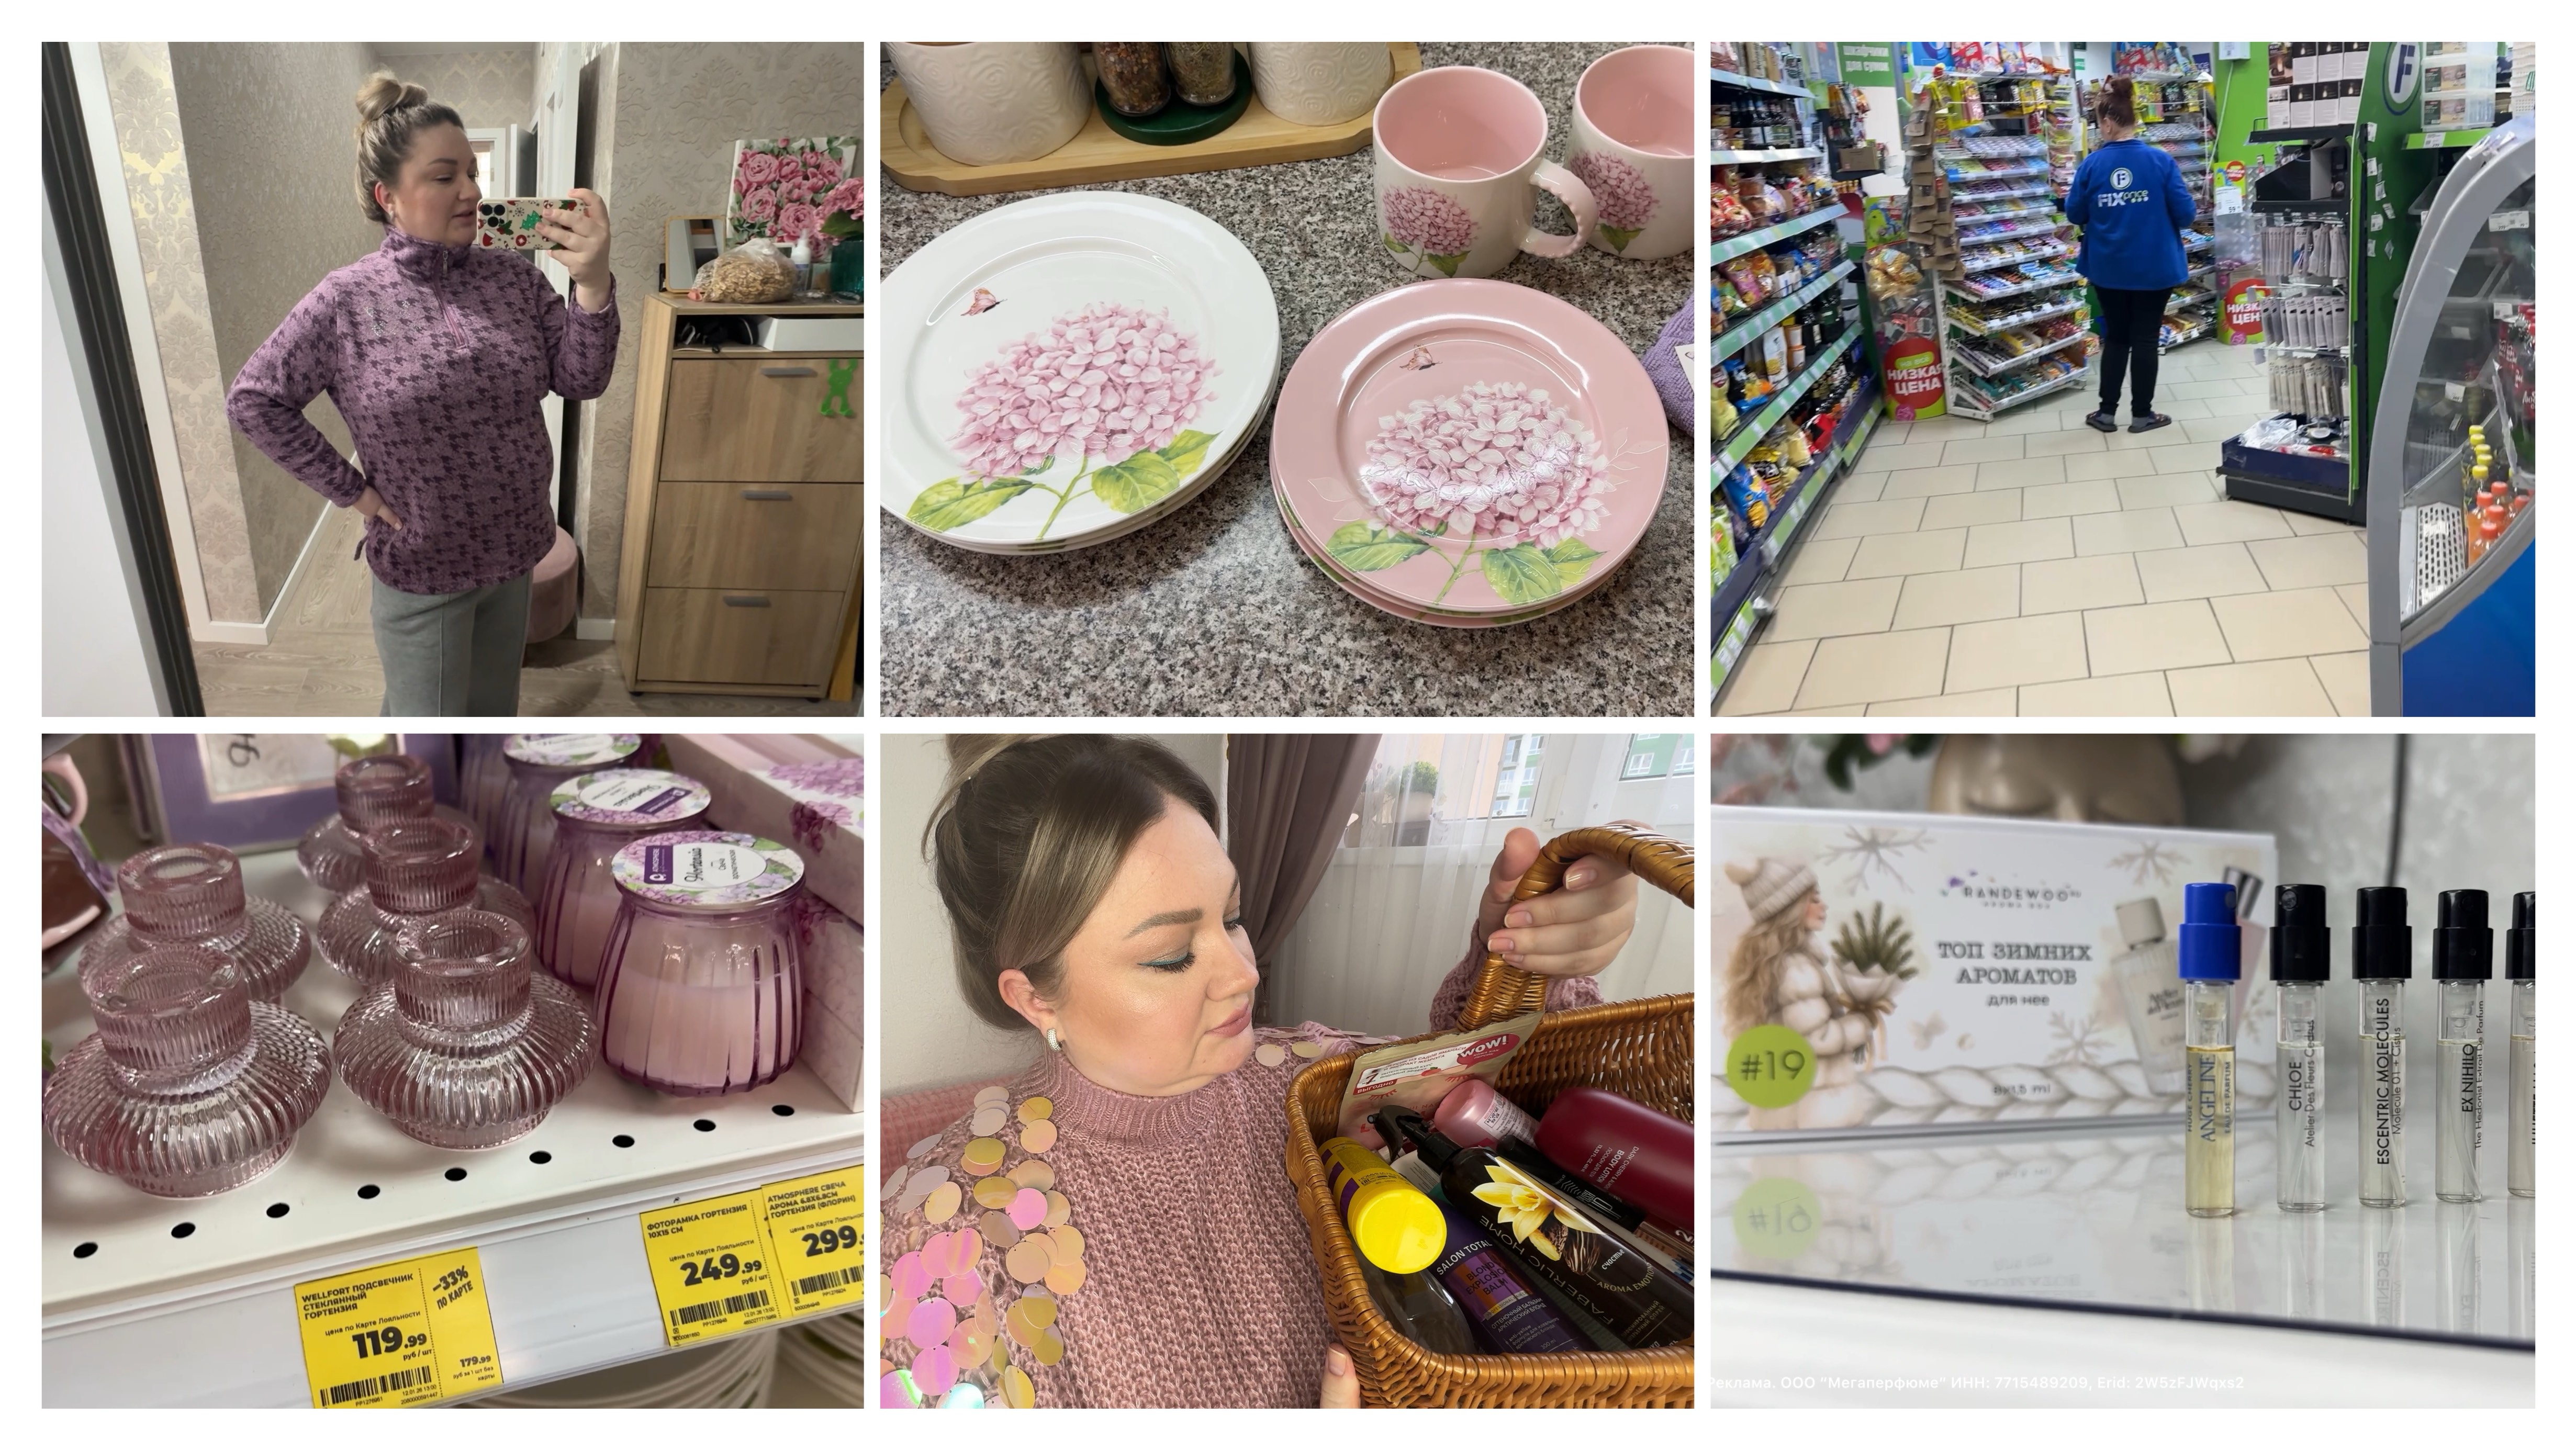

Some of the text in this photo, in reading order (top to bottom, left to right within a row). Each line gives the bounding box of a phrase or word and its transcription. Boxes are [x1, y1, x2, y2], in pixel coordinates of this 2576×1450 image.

[2233, 311, 2261, 325] ЦЕН
[1895, 377, 1942, 396] ЦЕНА
[1938, 942, 2093, 961] ТОП ЗИМНИХ
[1956, 968, 2077, 985] АРОМАТОВ
[1987, 995, 2018, 1007] для
[1460, 1035, 1509, 1059] WOW!
[2391, 1027, 2401, 1056] Cistus
[1741, 1049, 1805, 1081] #19
[2304, 1061, 2315, 1088] Fleurs
[1357, 1081, 1394, 1094] ВЫГОДНО
[2288, 1062, 2302, 1111] CHLOE
[2377, 998, 2389, 1164] ESCENTRIC MOLECULES
[2462, 1044, 2474, 1112] EX NIHILO
[2225, 1101, 2231, 1114] DE
[2304, 1093, 2315, 1112] Des
[2392, 1086, 2401, 1134] Molecule
[2304, 1115, 2315, 1147] Atelier
[1599, 1147, 1612, 1164] ЛОСЬОН
[1627, 1146, 1639, 1160] DARK
[1596, 1150, 1625, 1183] BODY LOTION
[1615, 1160, 1630, 1178] CHERRY
[768, 1182, 846, 1202] ATMOSPHERE СВЕЧА
[769, 1200, 799, 1211] АРОМА
[771, 1195, 856, 1219] ГОРТЕНЗИЯ (ФЛОРИН)
[647, 1205, 747, 1231] ФОТОРАМКА ГОРТЕНЗИЯ
[815, 1219, 834, 1228] Карте
[671, 1226, 684, 1234] СМ
[1480, 1216, 1525, 1255] HOME
[696, 1247, 715, 1257] Карте
[716, 1239, 754, 1252] Лояльности
[802, 1225, 864, 1257] 299.
[1437, 1240, 1493, 1275] SALON TOTAL
[1601, 1249, 1625, 1270] счастье
[680, 1253, 762, 1286] 249.99
[302, 1274, 413, 1302] WELLFORT ПОДСВЕЧНИК
[742, 1276, 753, 1285] руб
[1466, 1267, 1506, 1295] EXPLOSIO
[1483, 1278, 1508, 1295] BALM
[1528, 1255, 1614, 1325] FABERLIC
[1597, 1282, 1633, 1292] AROMA
[303, 1290, 367, 1311] СТЕКЛЯННЫЙ
[436, 1280, 473, 1310] ПО КАРТЕ
[305, 1303, 357, 1320] ГОРТЕНЗИЯ
[1492, 1298, 1543, 1329] ОТТЕНОЧНЫЙ БАЛЬЗАМ
[1498, 1303, 1547, 1333] АРКТИЧЕСКИЙ БЛОНД
[325, 1328, 343, 1336] цена
[356, 1320, 377, 1331] Карте
[379, 1311, 420, 1324] Лояльности
[1509, 1324, 1531, 1342] anti-yellow
[352, 1326, 427, 1359] 119.99
[1540, 1341, 1550, 1350] 300
[403, 1351, 417, 1361] руб
[460, 1355, 491, 1367] 179.99
